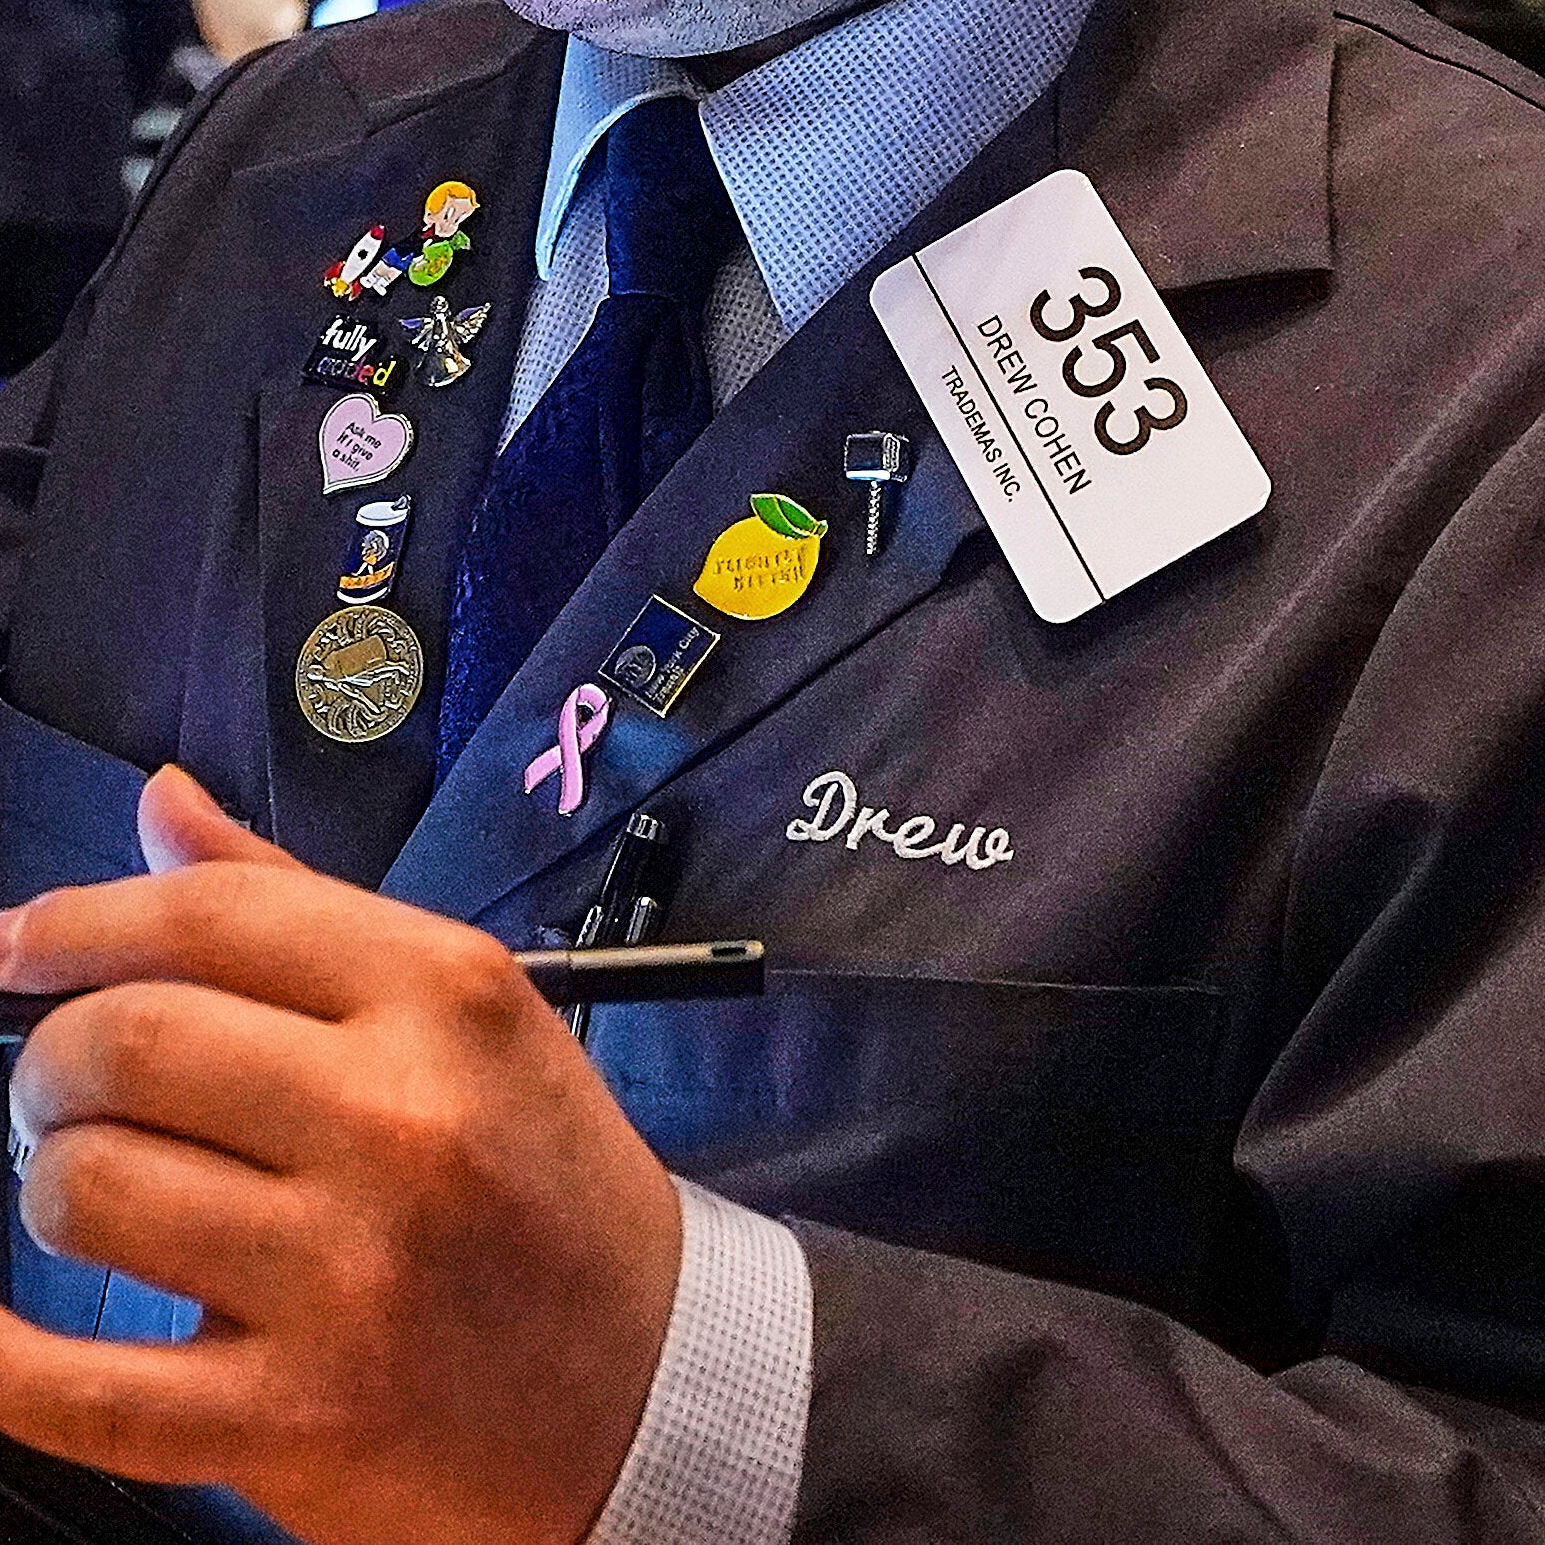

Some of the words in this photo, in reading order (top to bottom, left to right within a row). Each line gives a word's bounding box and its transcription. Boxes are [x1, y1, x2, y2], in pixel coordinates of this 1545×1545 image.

[322, 319, 377, 361] fully
[1029, 266, 1188, 456] 353
[344, 422, 365, 439] Ask
[364, 435, 382, 449] me
[351, 443, 373, 461] give
[942, 365, 1002, 463] TRADEMAS
[993, 462, 1021, 503] INC.
[977, 315, 1037, 394] DREW
[1024, 398, 1092, 495] COHEN
[786, 770, 1014, 871] Drew
